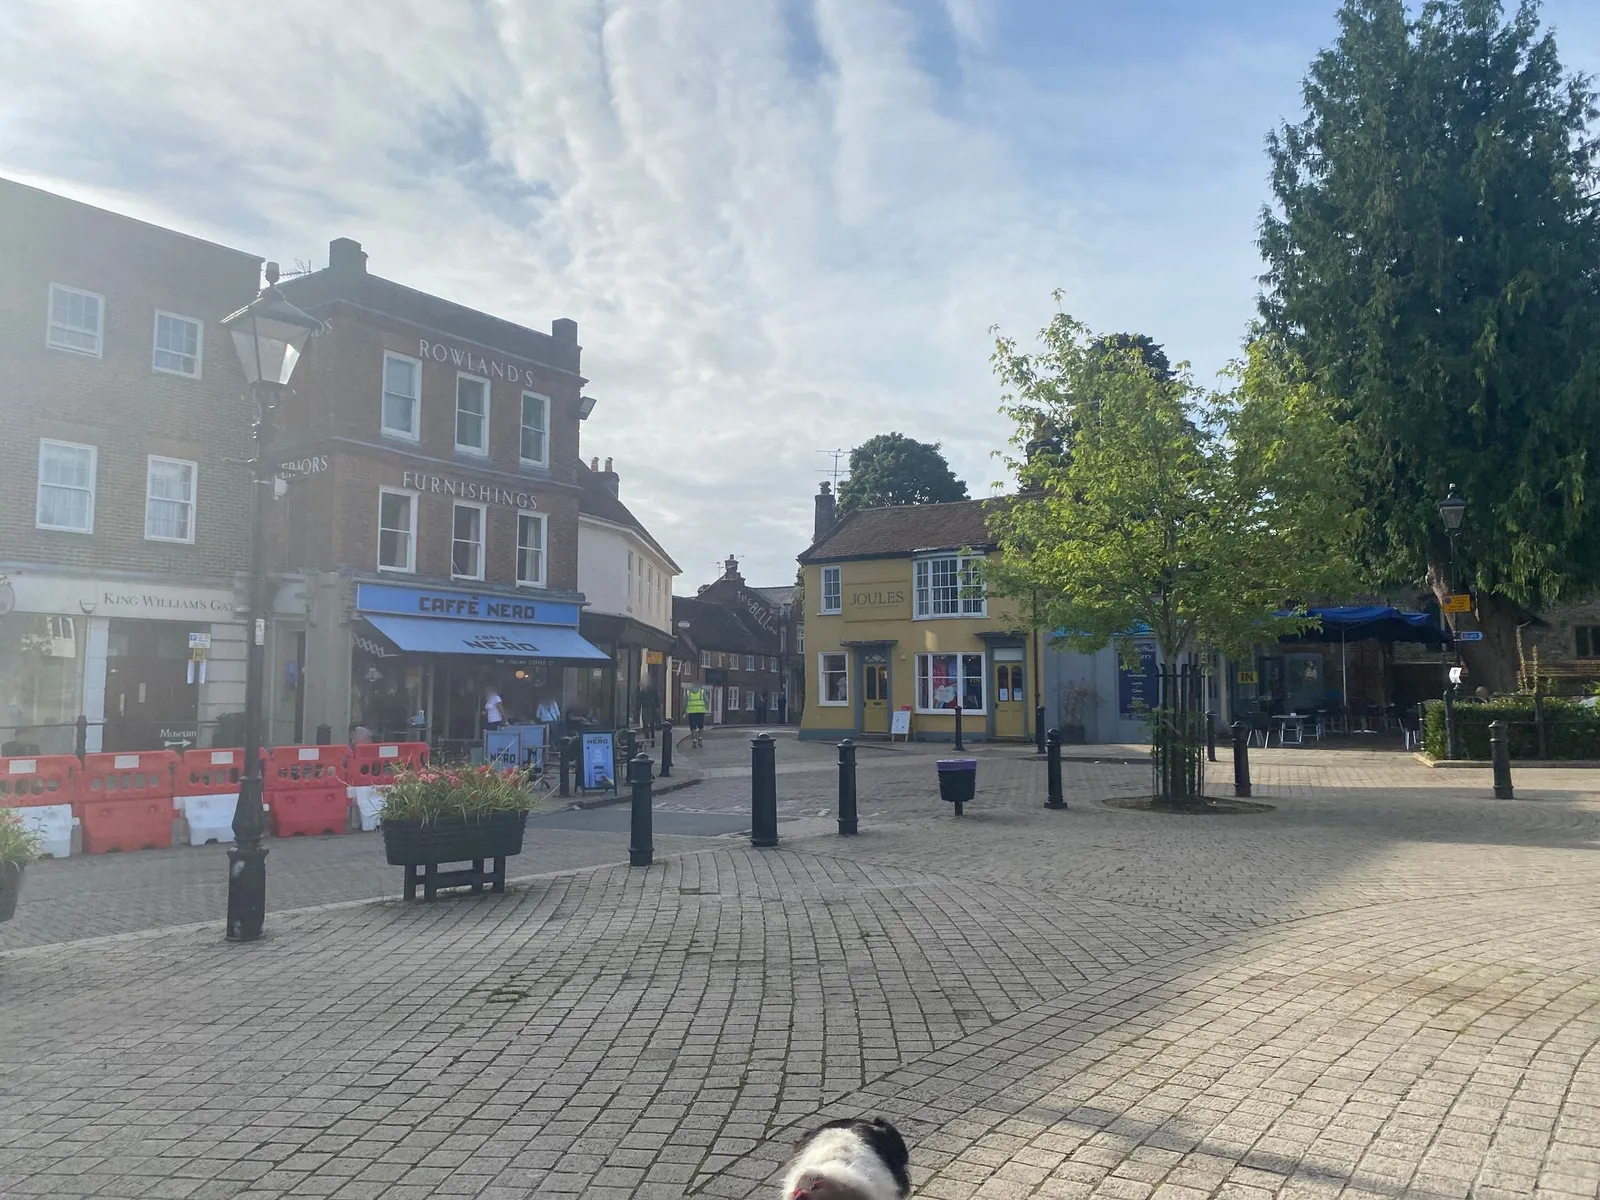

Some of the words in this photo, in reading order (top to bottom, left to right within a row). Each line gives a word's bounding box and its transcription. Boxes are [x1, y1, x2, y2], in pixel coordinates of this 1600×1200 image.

[420, 338, 533, 387] ROWLAND'S
[281, 455, 328, 479] ERIORS
[403, 471, 537, 510] FURNISHINGS
[104, 592, 139, 606] KING
[850, 591, 904, 606] JOULES
[487, 603, 535, 619] NERO
[737, 591, 752, 606] THE
[749, 602, 772, 631] BELL
[462, 639, 541, 652] NERO
[1241, 672, 1253, 682] IN
[160, 729, 197, 738] Museum
[490, 753, 516, 764] NERO
